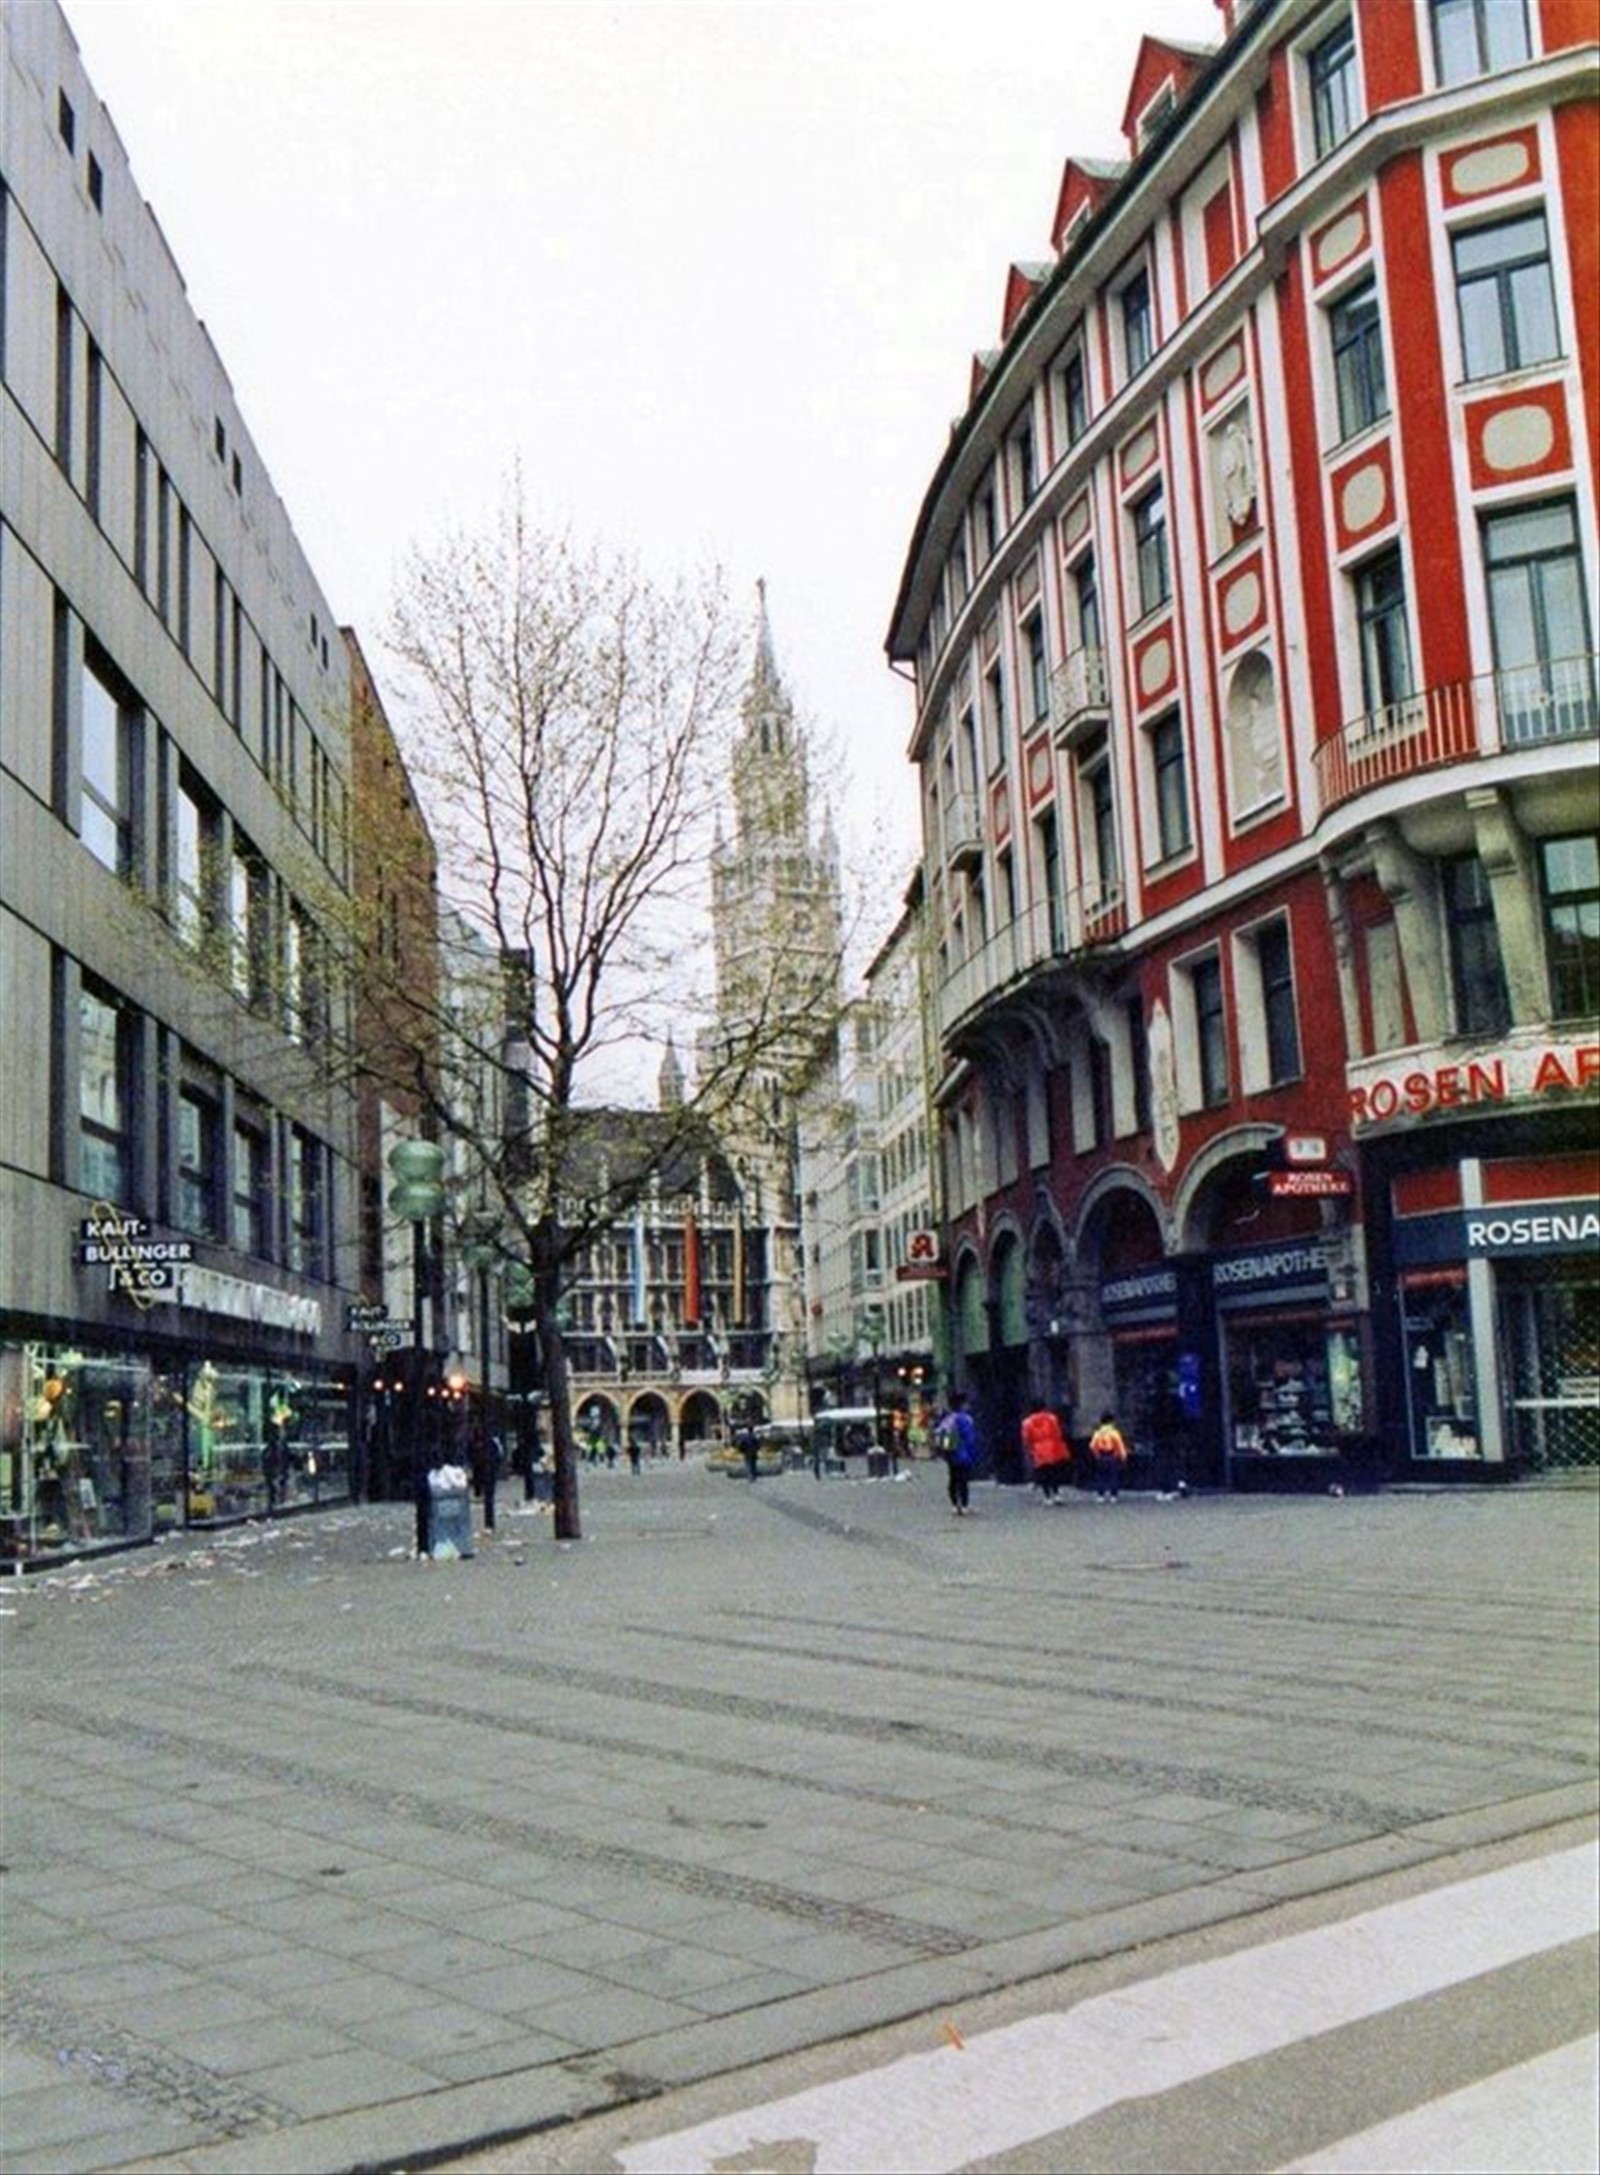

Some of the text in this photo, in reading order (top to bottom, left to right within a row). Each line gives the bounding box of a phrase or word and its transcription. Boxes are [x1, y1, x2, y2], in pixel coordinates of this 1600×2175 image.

[1350, 1060, 1506, 1121] ROSEN
[1467, 1213, 1600, 1247] ROSENA
[85, 1244, 191, 1262] BULLINGER
